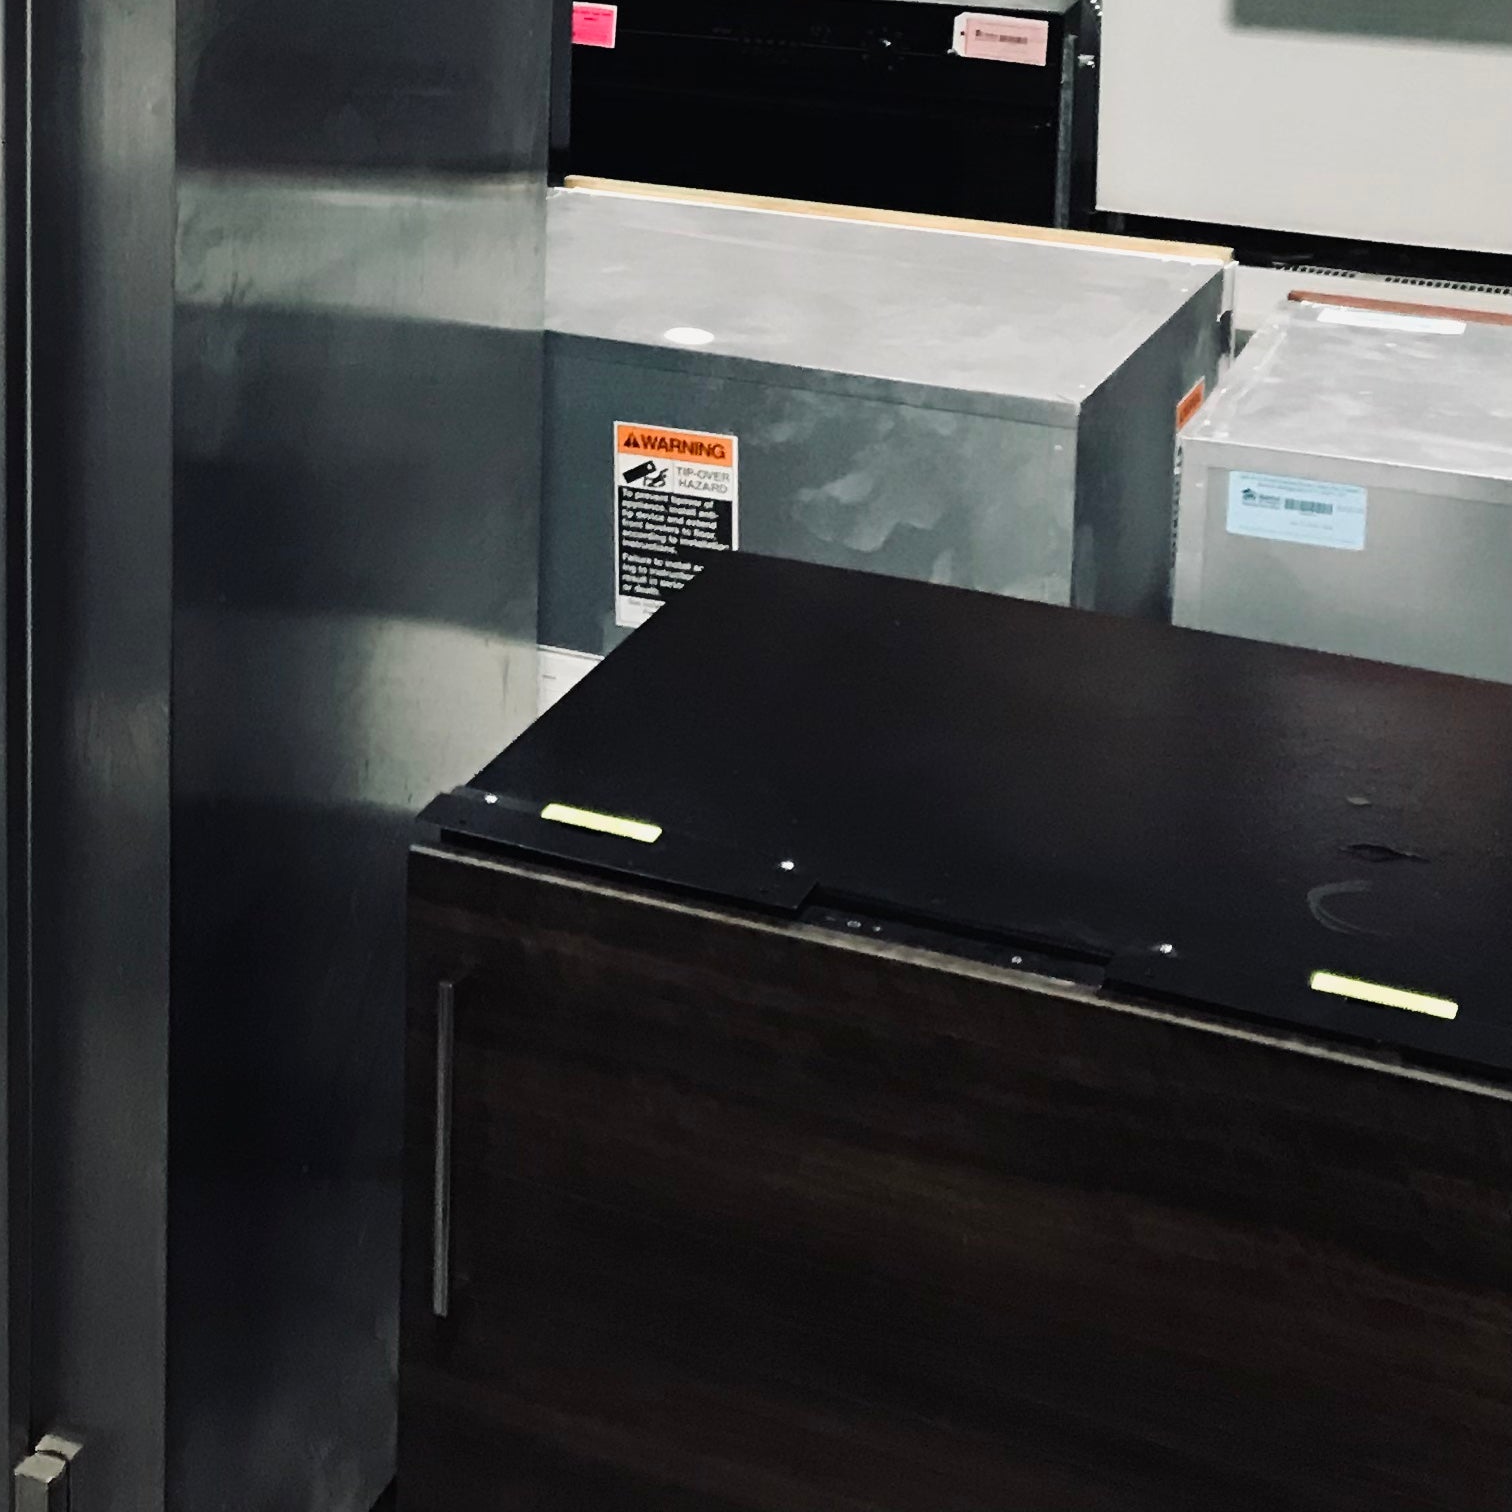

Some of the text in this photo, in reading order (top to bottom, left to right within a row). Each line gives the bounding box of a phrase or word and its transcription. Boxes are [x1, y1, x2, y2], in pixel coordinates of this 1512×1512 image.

[640, 434, 726, 460] WARNING
[676, 466, 730, 483] TIP-OVER
[678, 479, 728, 494] HAZARD
